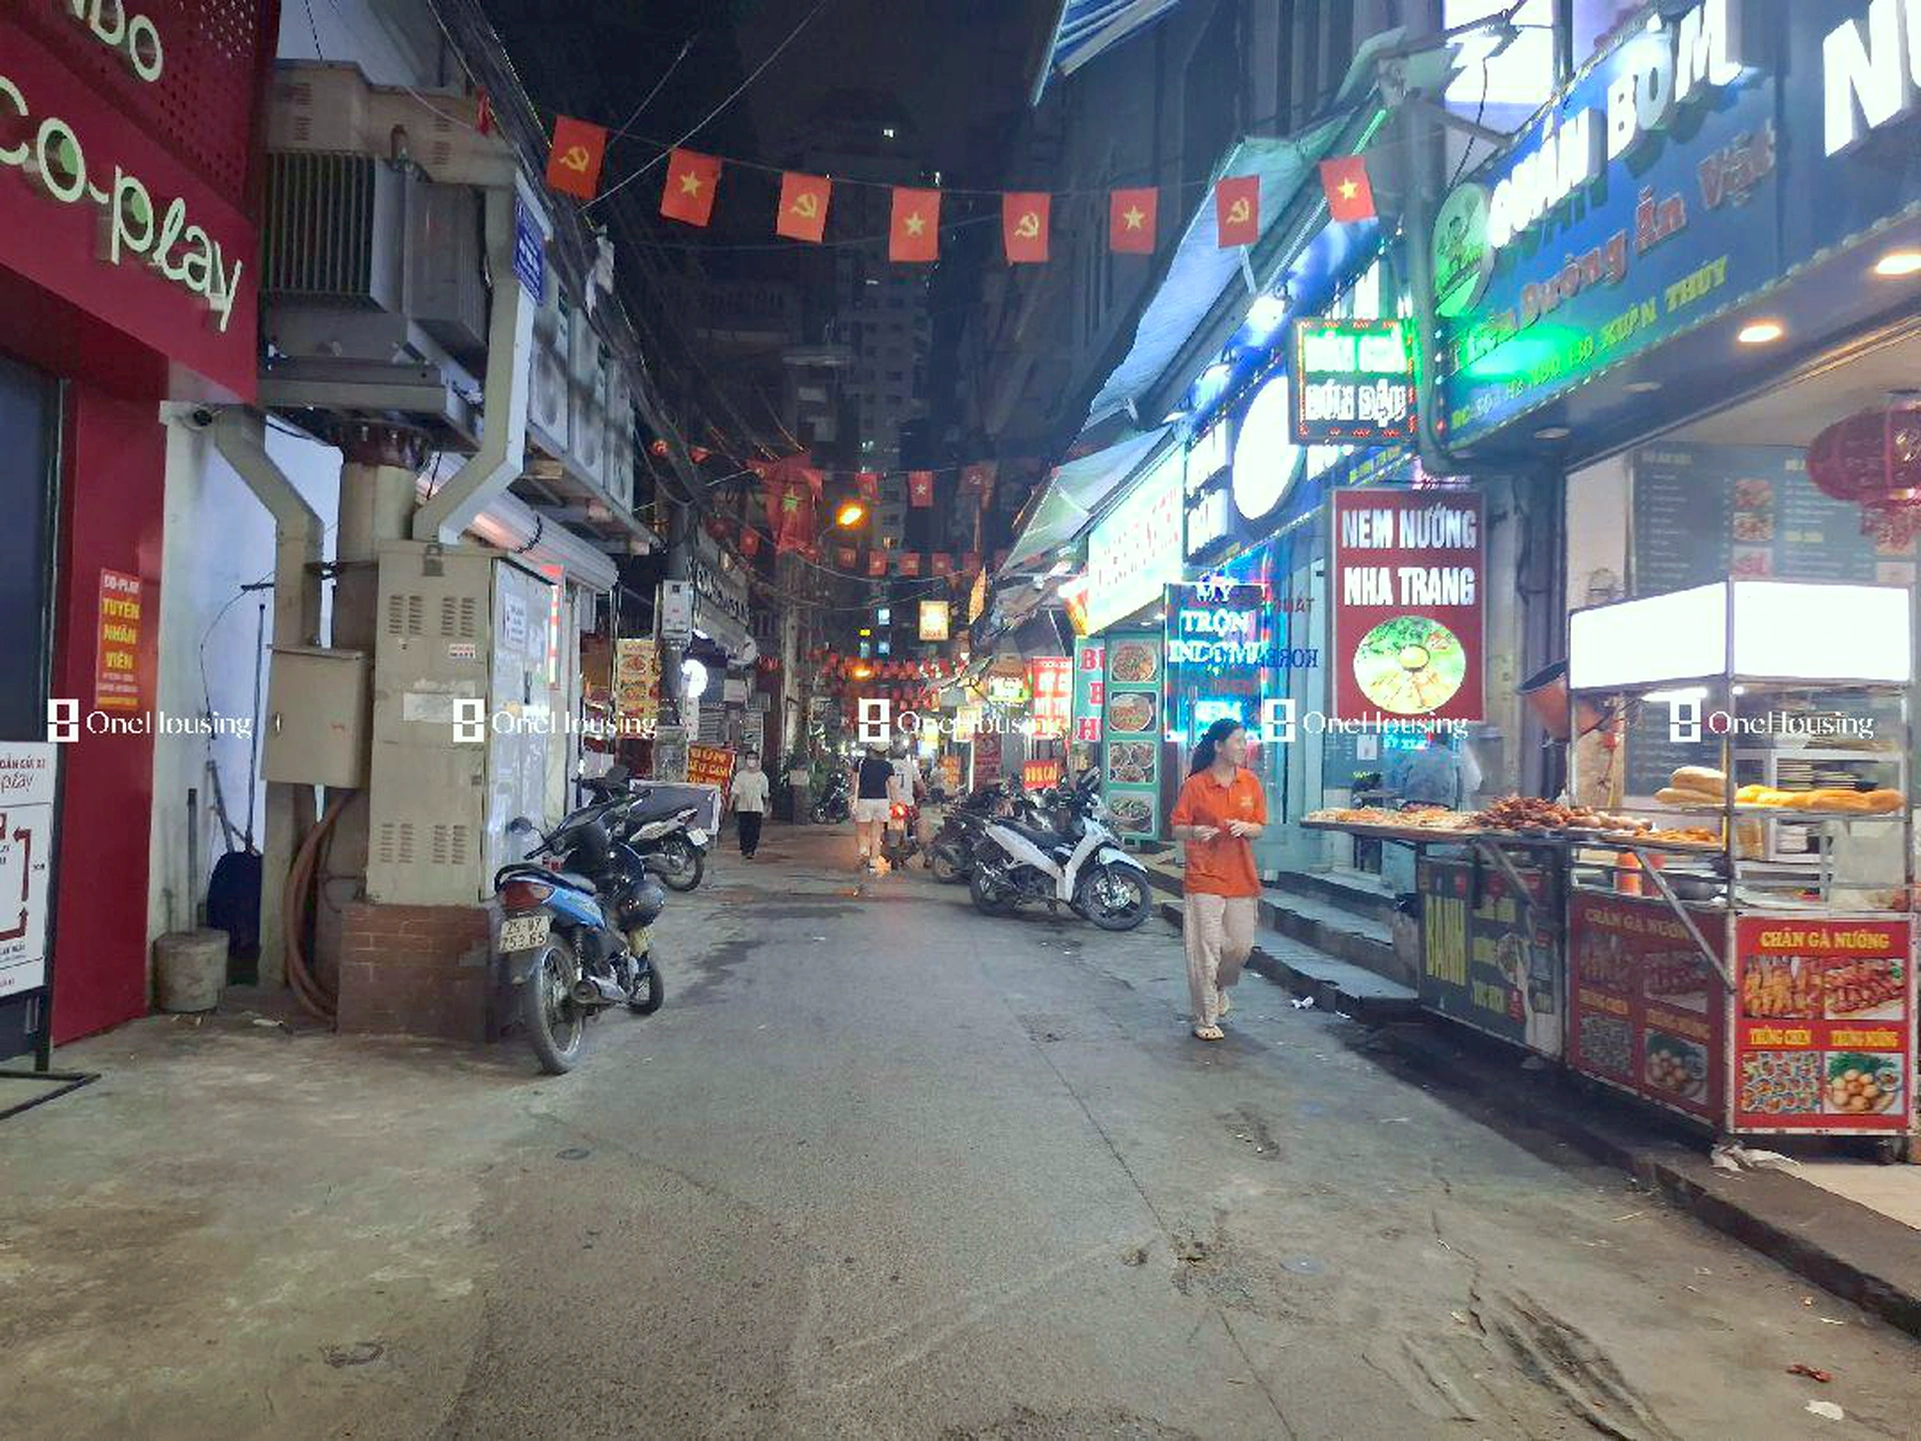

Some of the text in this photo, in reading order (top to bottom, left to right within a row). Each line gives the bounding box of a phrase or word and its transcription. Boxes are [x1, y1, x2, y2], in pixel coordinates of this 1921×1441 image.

[1342, 502, 1477, 549] NEM NƯỚNG
[1344, 567, 1394, 606] NHA
[1398, 567, 1475, 606] TRANG
[1760, 928, 1804, 948] CHÂN
[1808, 928, 1832, 949] GÀ
